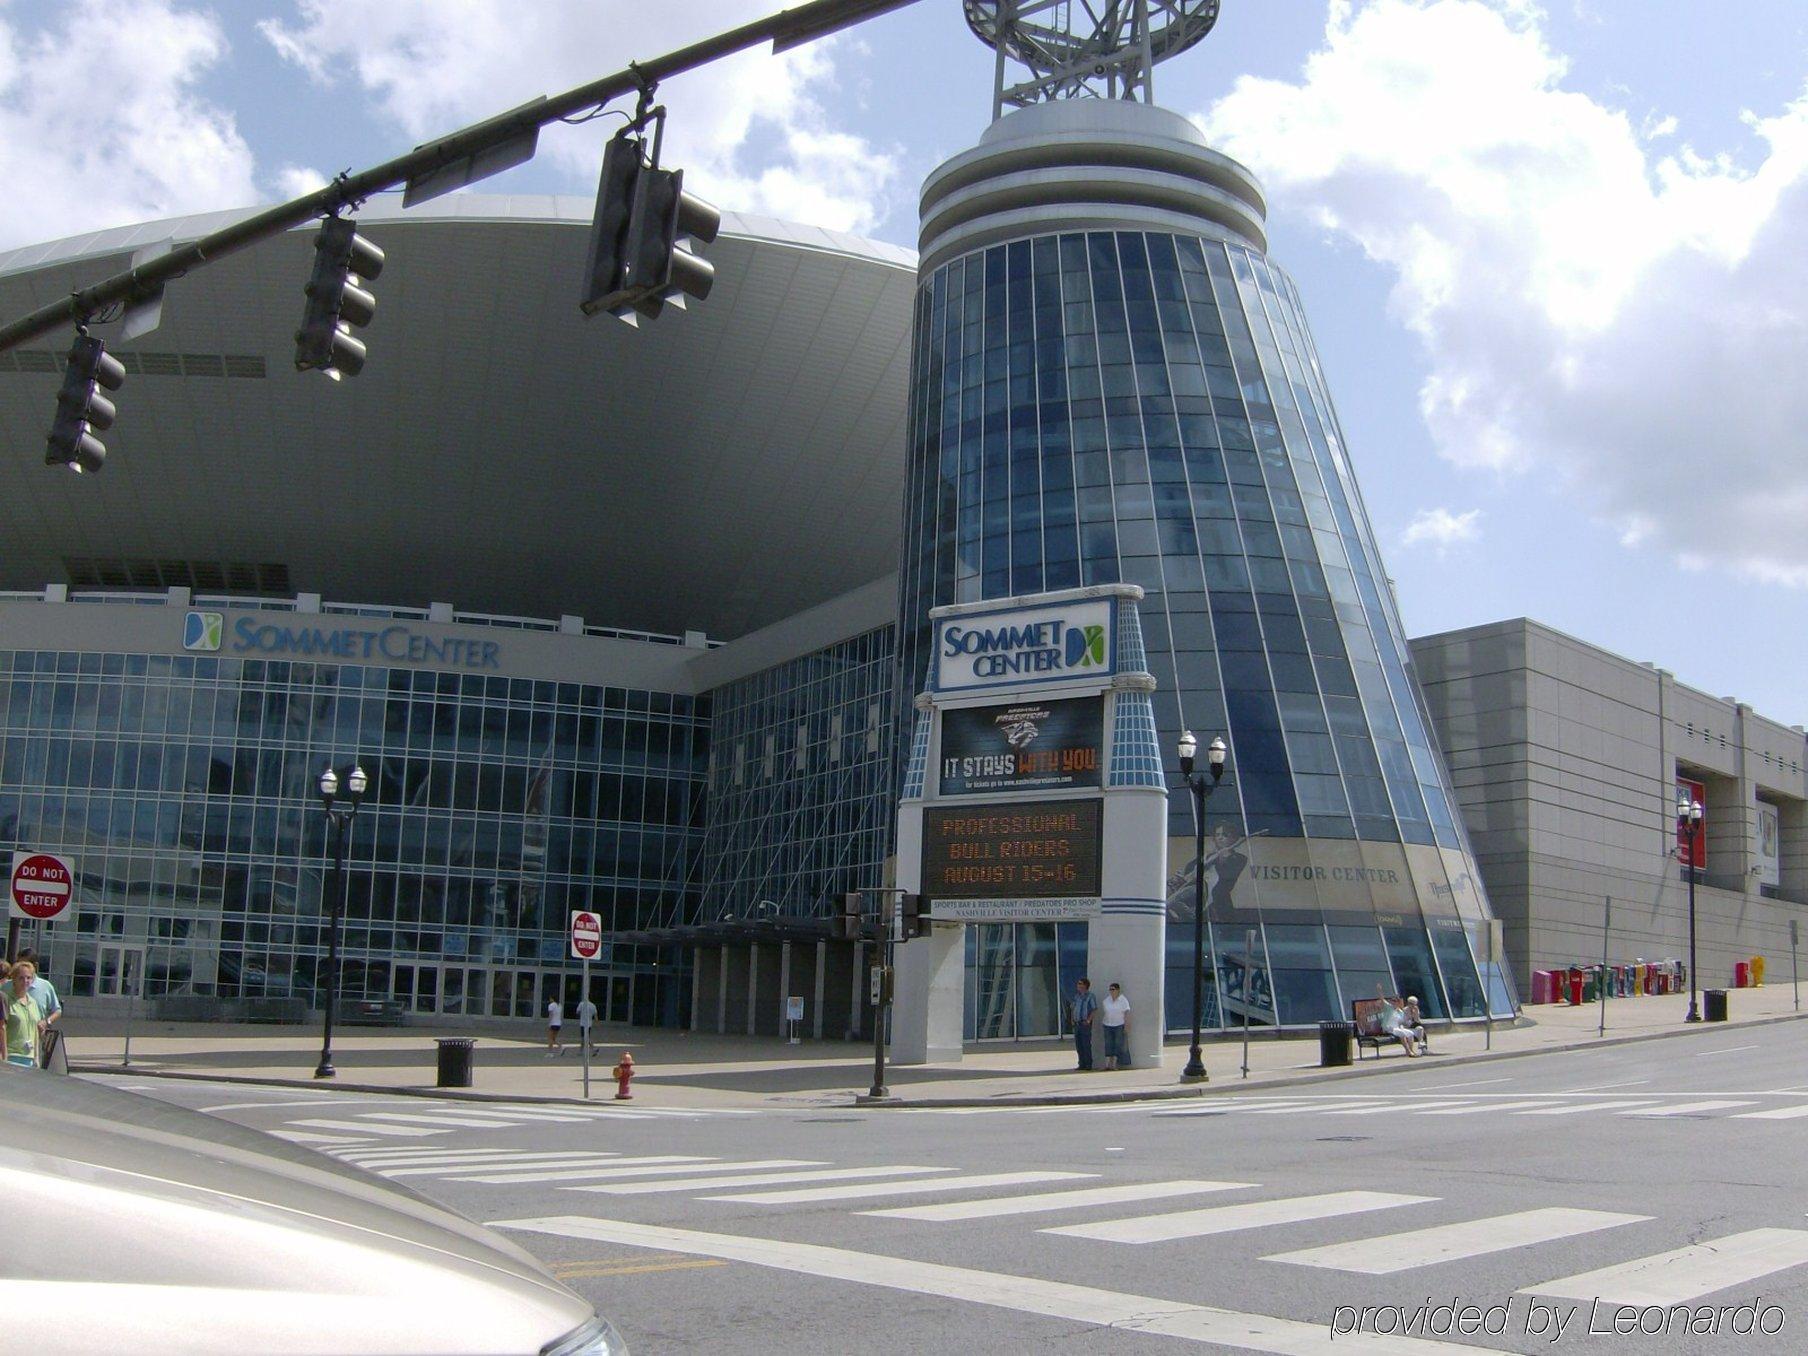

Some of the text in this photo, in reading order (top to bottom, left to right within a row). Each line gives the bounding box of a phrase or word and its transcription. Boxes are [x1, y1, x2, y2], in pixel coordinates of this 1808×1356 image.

[944, 620, 1065, 657] SOMMET
[973, 649, 1063, 677] CENTER
[944, 758, 959, 778] IT
[963, 754, 1015, 778] STAYS
[1018, 749, 1059, 774] WITH
[943, 814, 1082, 836] PROFESSIONAL
[949, 839, 1070, 860] BULL RIDERS
[22, 866, 64, 879] DO NOT
[944, 863, 1077, 885] AUGUST 15-16
[1250, 865, 1399, 884] VISITOR CENTER
[24, 895, 57, 906] ENTER
[934, 901, 957, 909] SPORTS
[978, 900, 1018, 908] RESTAURANT
[1024, 899, 1062, 908] PREDATORS
[1063, 899, 1077, 907] PRO
[1079, 898, 1097, 906] SHOP
[955, 908, 1062, 917] NASHVILLE VISITOR CENTER
[576, 920, 597, 930] DO NOT
[578, 940, 595, 950] ENTER
